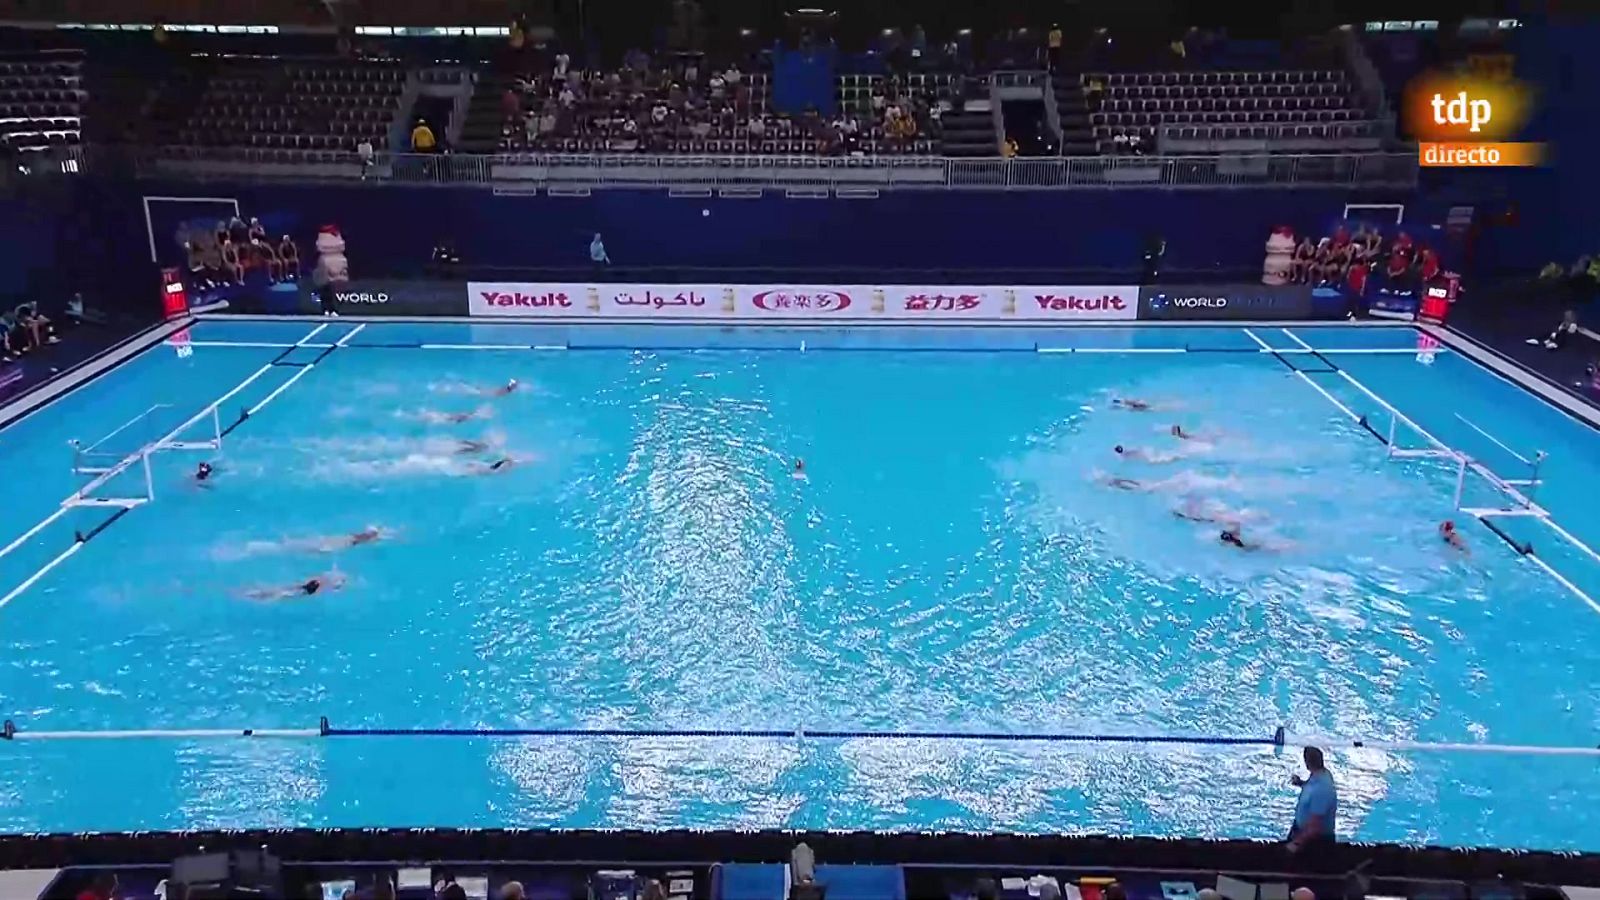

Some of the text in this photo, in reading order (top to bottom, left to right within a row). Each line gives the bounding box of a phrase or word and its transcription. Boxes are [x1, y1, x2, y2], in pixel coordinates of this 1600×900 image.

[335, 292, 389, 304] WORLD
[480, 291, 573, 308] Yakult
[904, 294, 981, 311] 益力多
[1034, 294, 1127, 311] Yakult
[1173, 297, 1227, 308] WORLD
